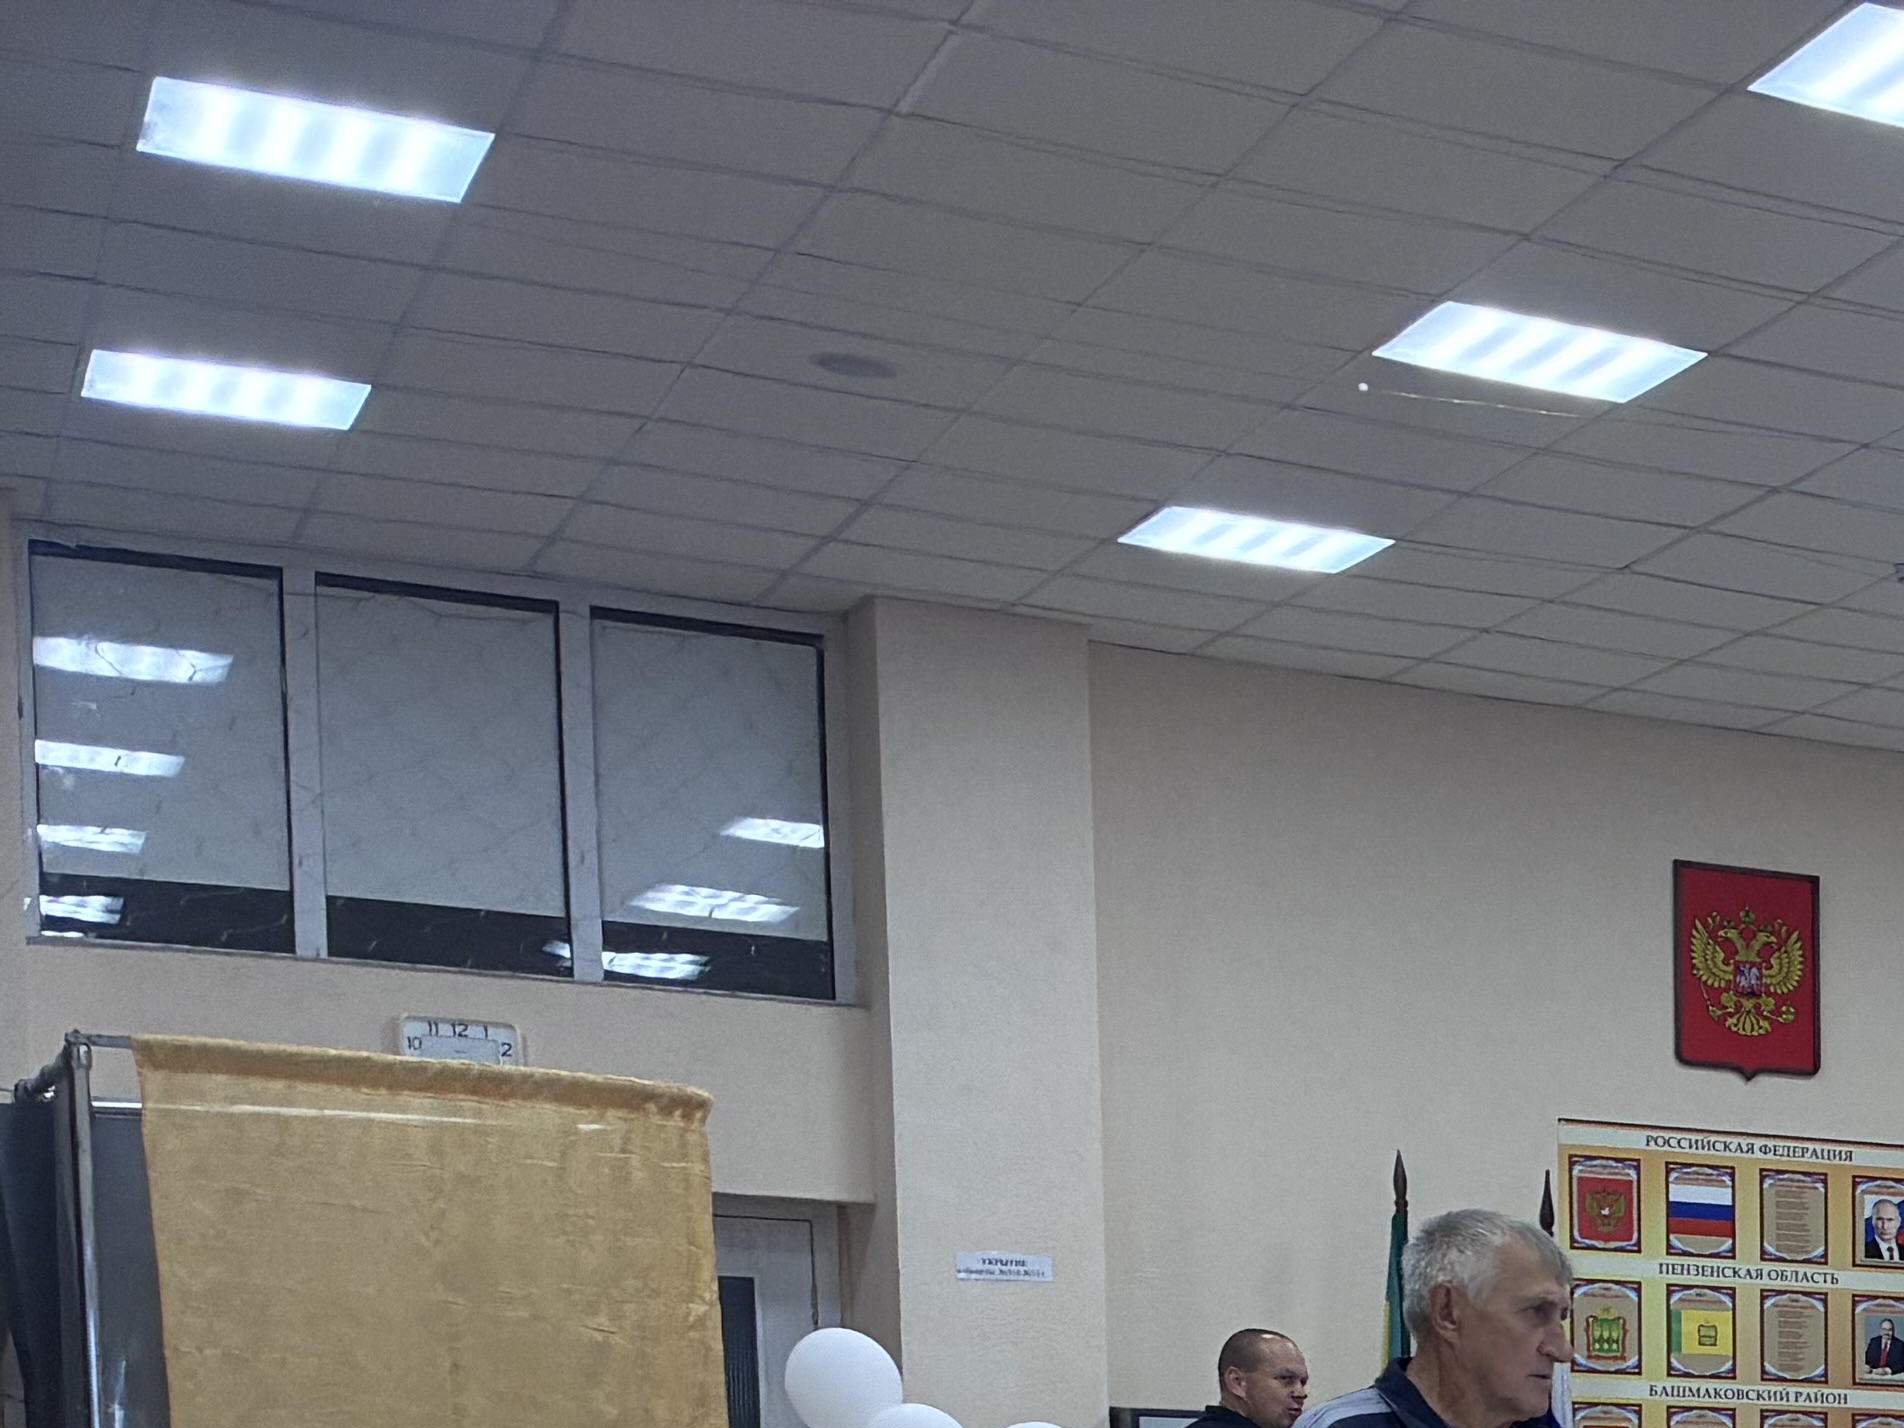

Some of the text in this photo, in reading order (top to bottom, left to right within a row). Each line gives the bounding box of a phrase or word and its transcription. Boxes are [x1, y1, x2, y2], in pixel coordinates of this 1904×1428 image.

[428, 1021, 439, 1036] 11
[451, 1023, 469, 1038] 12
[407, 1036, 422, 1051] 10
[501, 1042, 513, 1057] 2
[1645, 1134, 1854, 1162] РОССИЙСКАЯ ФЕДЕРАЦИЯ
[1658, 1262, 1839, 1285] ПЕНЗЕНСКАЯ ОБЛАСТЬ
[1649, 1384, 1848, 1405] БАШМАКОВСКИЙ РАЙОН
